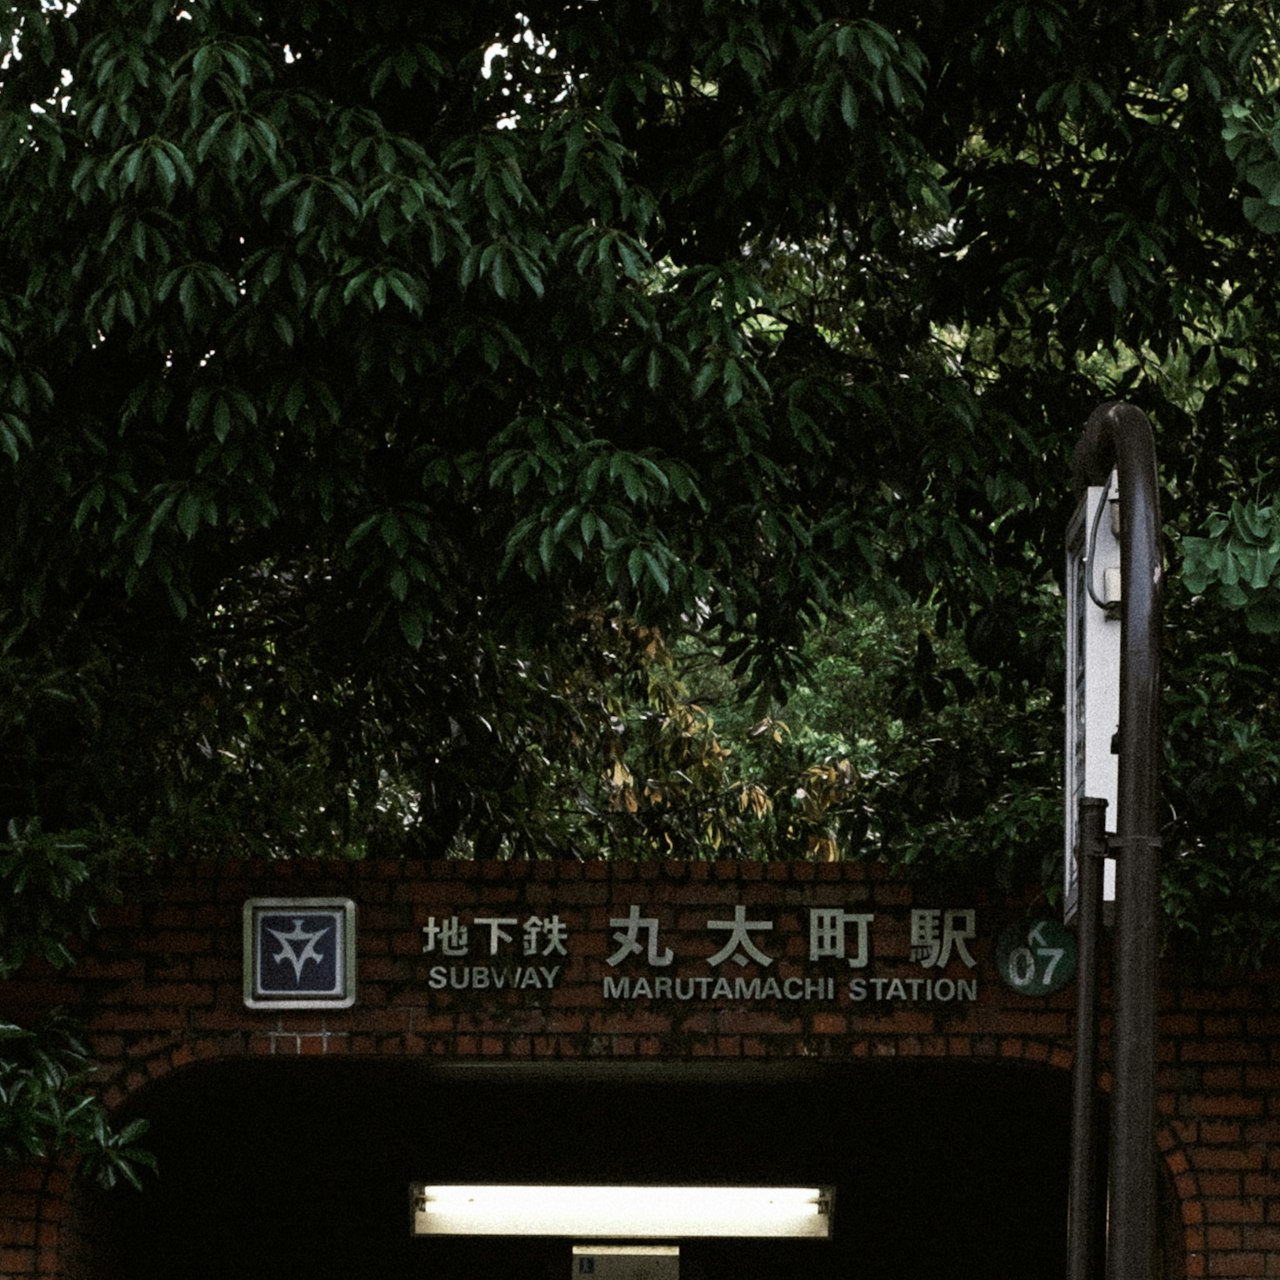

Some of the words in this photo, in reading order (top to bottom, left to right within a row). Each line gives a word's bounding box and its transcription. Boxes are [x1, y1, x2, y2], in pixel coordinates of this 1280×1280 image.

[422, 915, 569, 956] 地下鉄
[606, 904, 976, 968] 丸太町駅
[428, 965, 561, 990] SUBWAY
[603, 976, 835, 1000] MARUTAMACHI
[848, 978, 978, 1001] STATION
